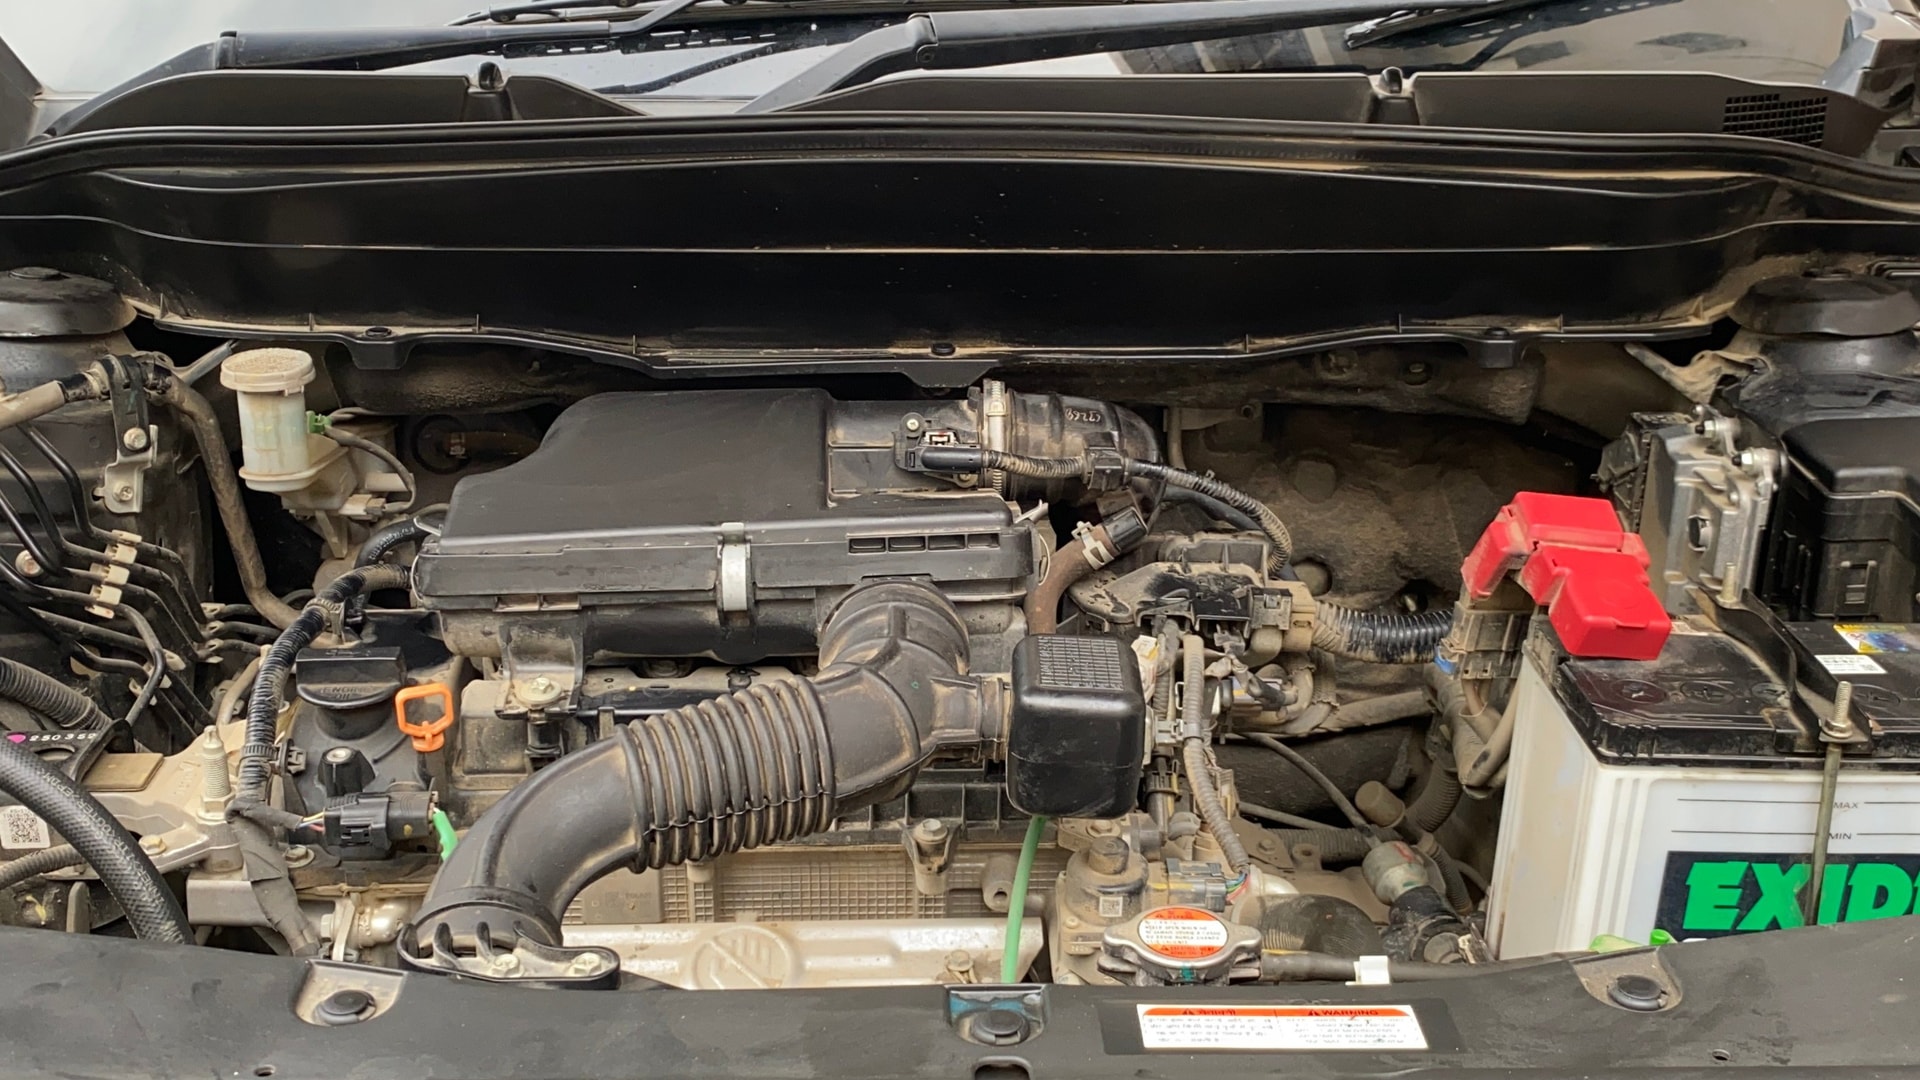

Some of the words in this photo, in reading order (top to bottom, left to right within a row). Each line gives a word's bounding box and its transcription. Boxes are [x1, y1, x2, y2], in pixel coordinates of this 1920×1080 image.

[1833, 801, 1859, 809] MAX
[1828, 832, 1852, 840] MIN
[1682, 860, 1920, 931] EXID
[1321, 1008, 1379, 1016] WARNING
